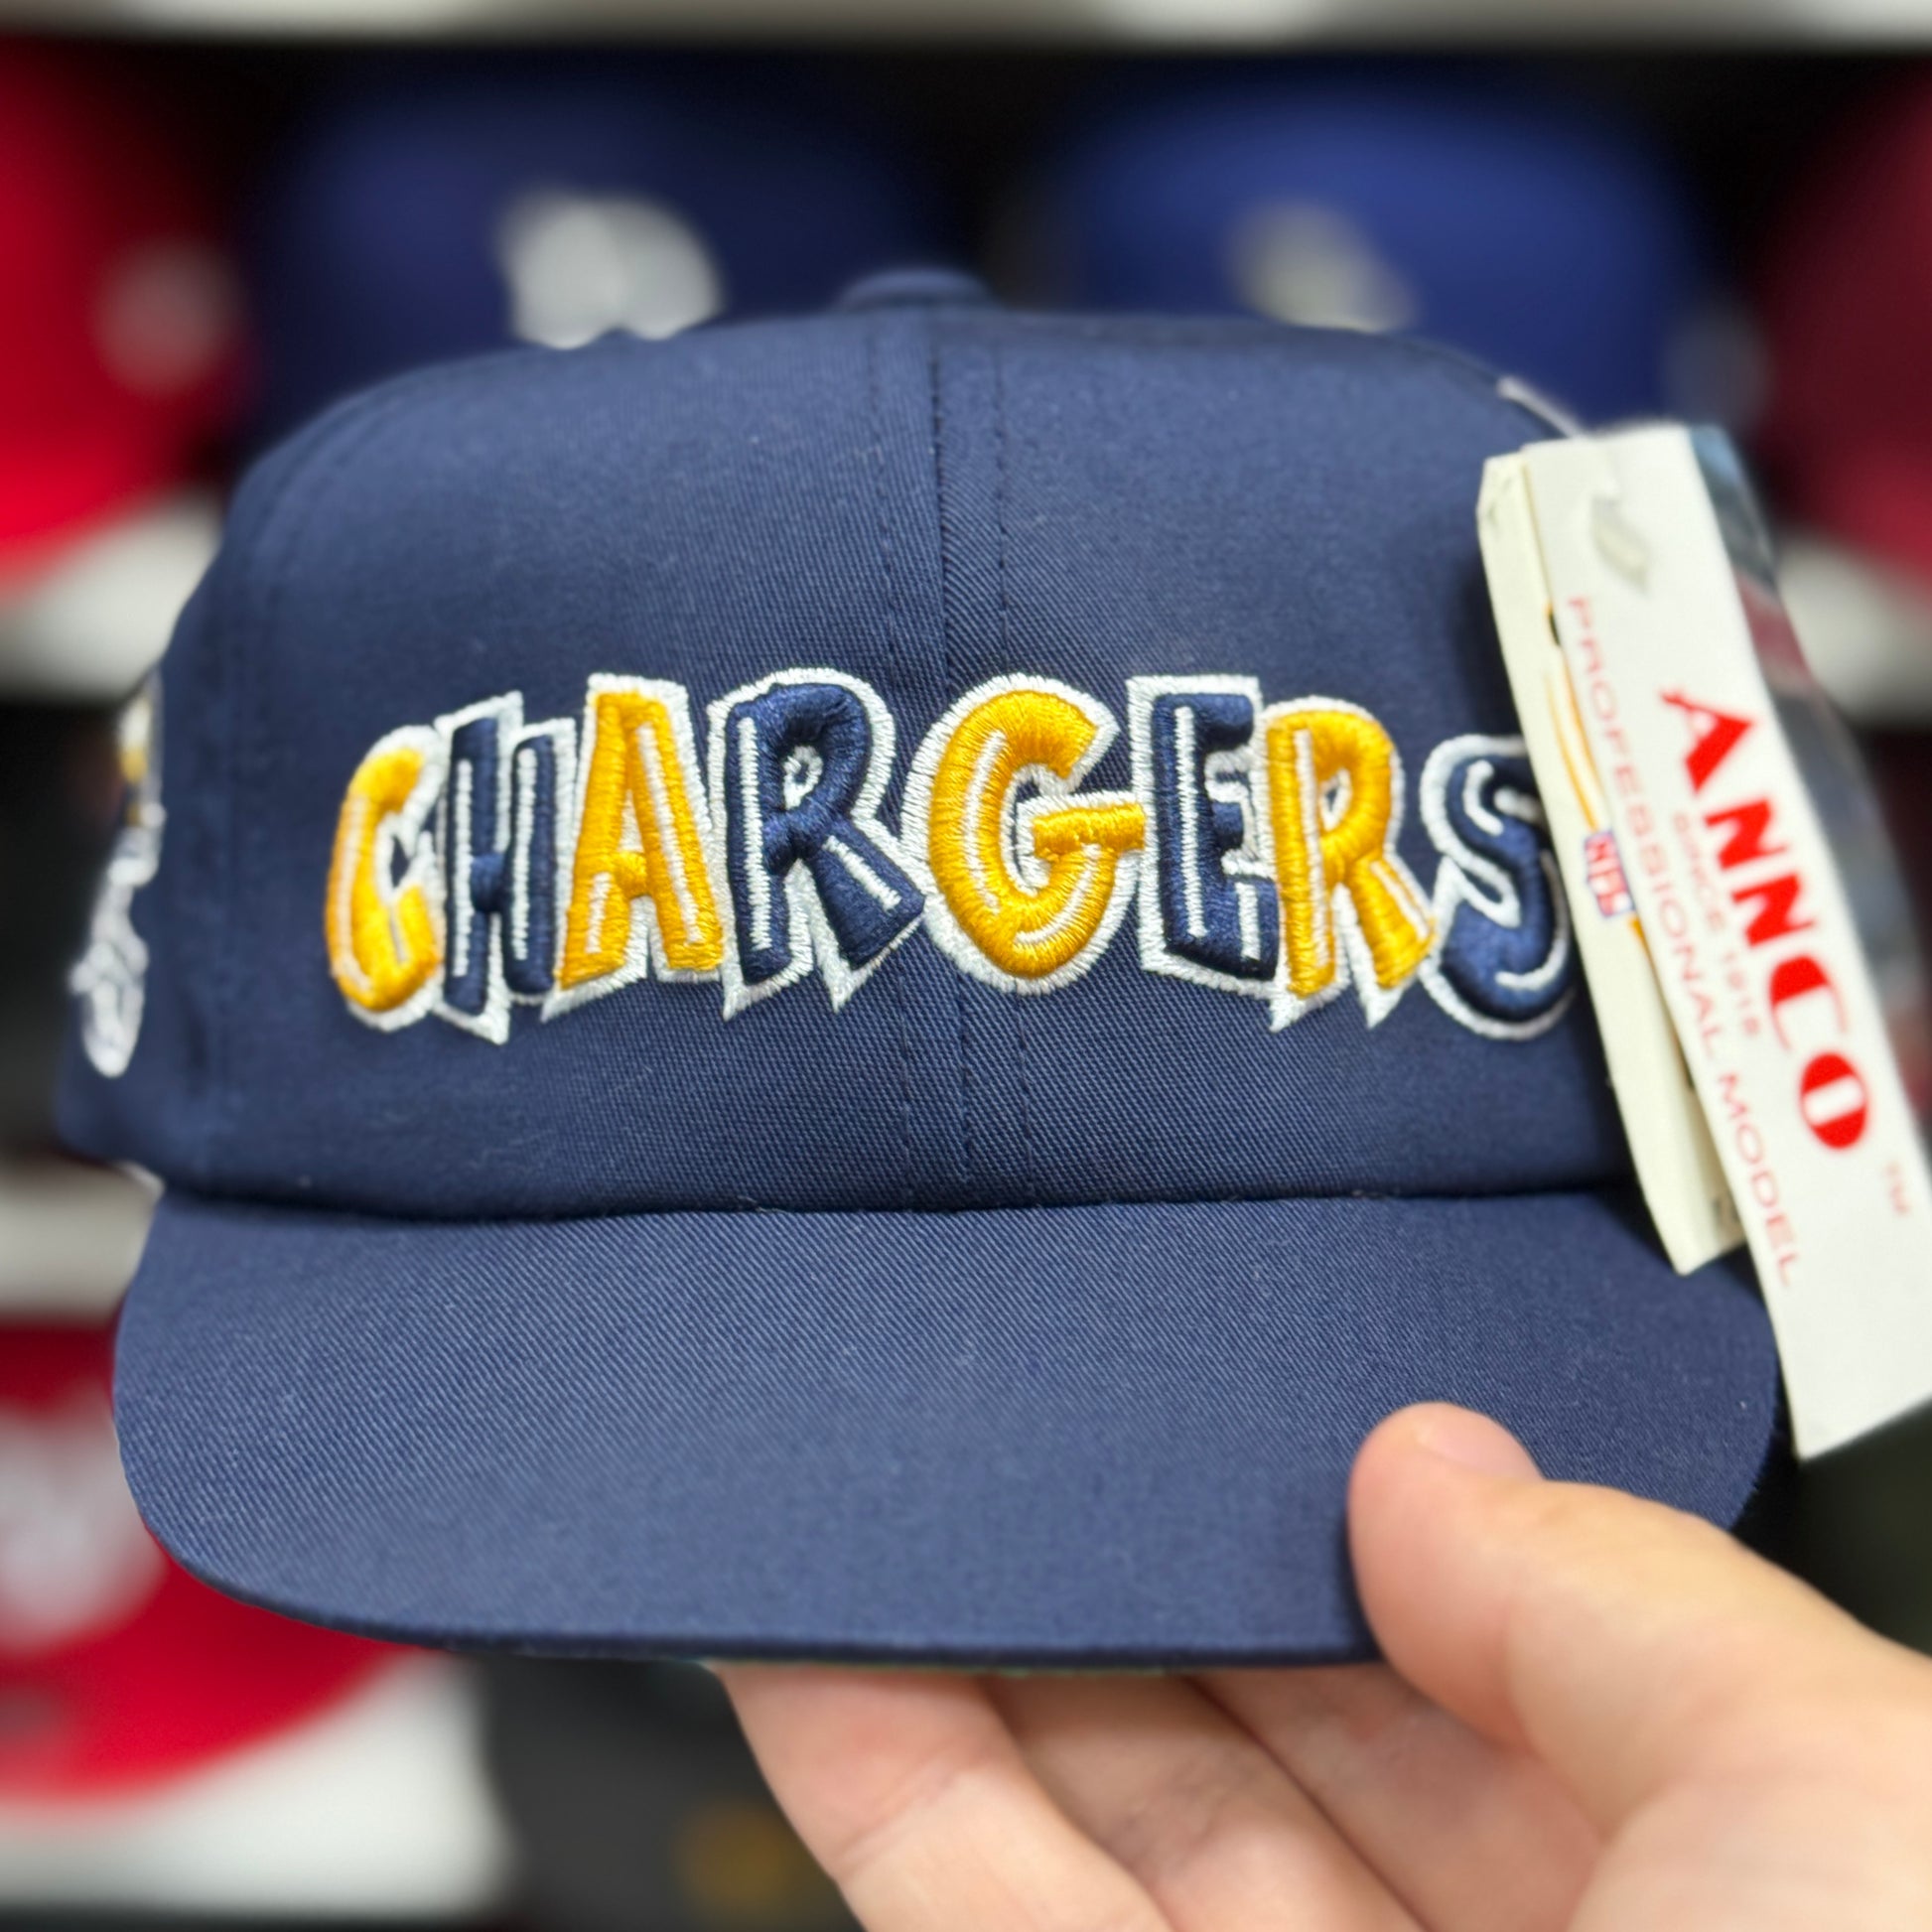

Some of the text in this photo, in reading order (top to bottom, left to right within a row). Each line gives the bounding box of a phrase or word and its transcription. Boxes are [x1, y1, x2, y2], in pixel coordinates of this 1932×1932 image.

[328, 668, 1573, 1043] CHARGERS
[1568, 597, 1798, 1287] PROFESSIONAL MODEL
[1661, 690, 1868, 1151] ANNCO
